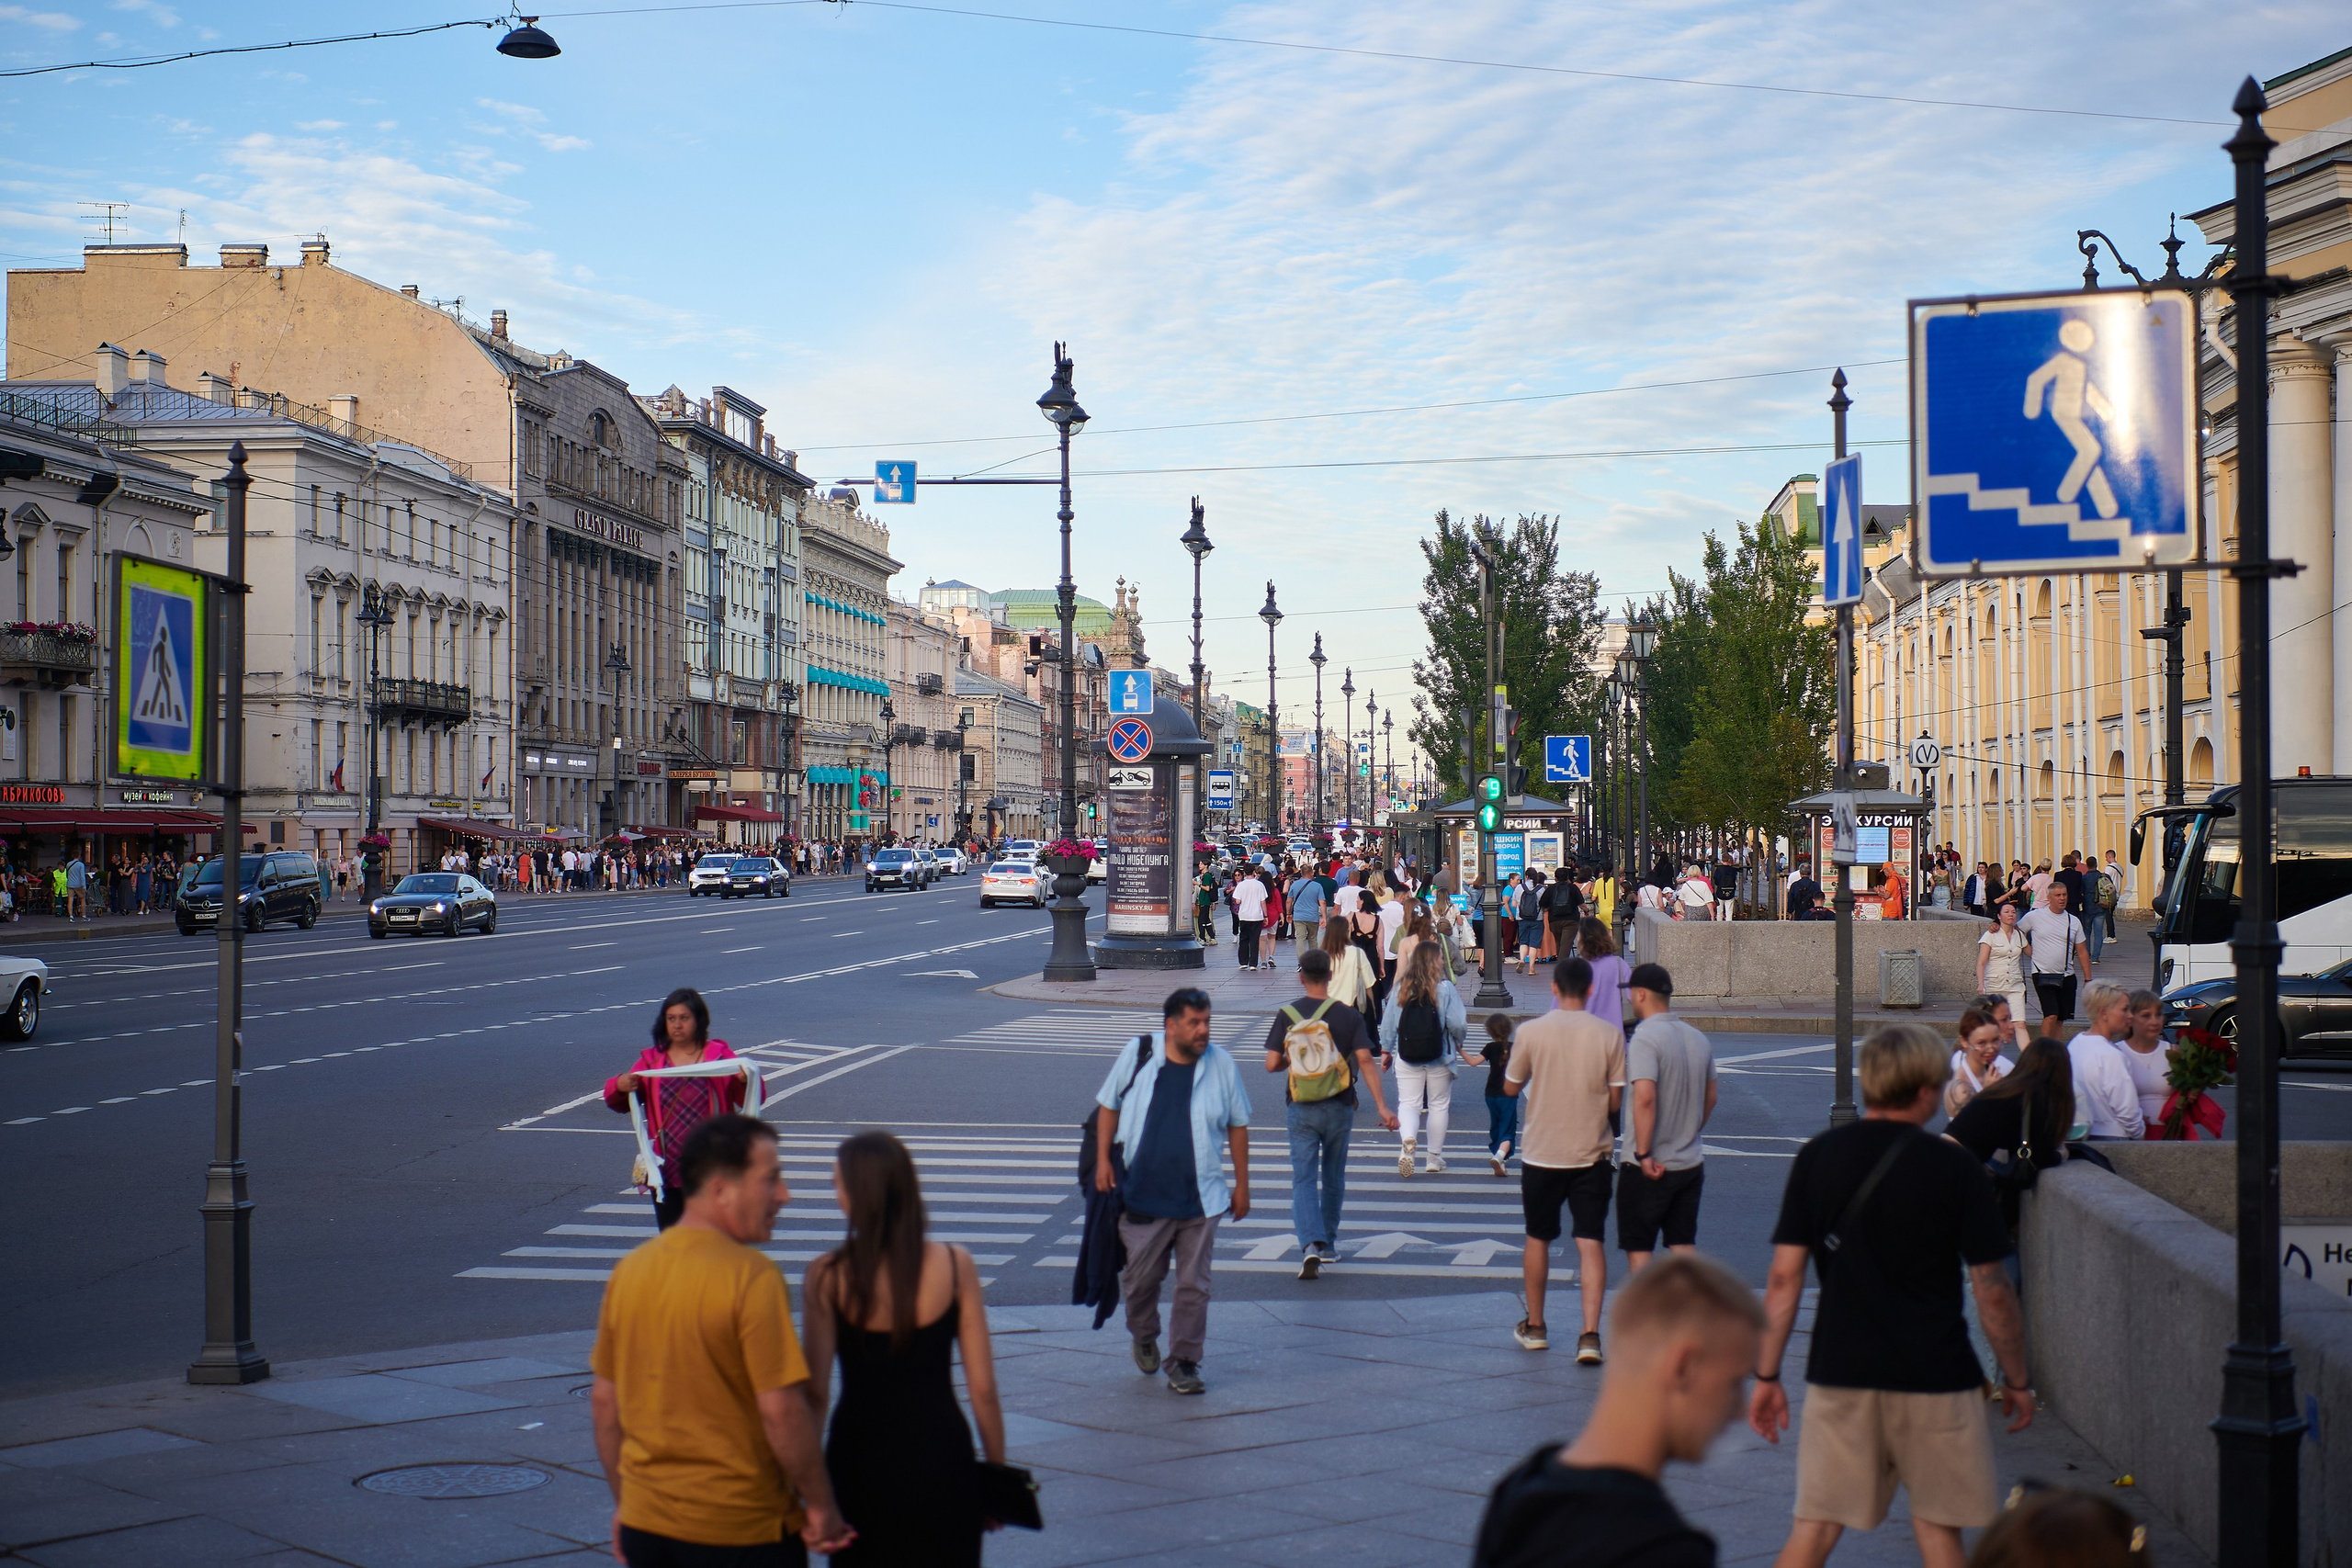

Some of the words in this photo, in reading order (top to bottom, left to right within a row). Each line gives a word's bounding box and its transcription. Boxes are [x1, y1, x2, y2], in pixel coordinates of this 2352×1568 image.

[575, 509, 608, 536] GRAND
[610, 521, 644, 548] PALACE
[669, 771, 691, 779] ГАЛЕРЕЯ
[692, 770, 717, 778] БУТИКОВ
[3, 786, 65, 803] АБРИКОСОВЪ
[1490, 781, 1499, 796] 9
[123, 790, 142, 803] музей
[148, 790, 174, 804] кофейня
[1822, 816, 1913, 827] ЭКУРСИИ
